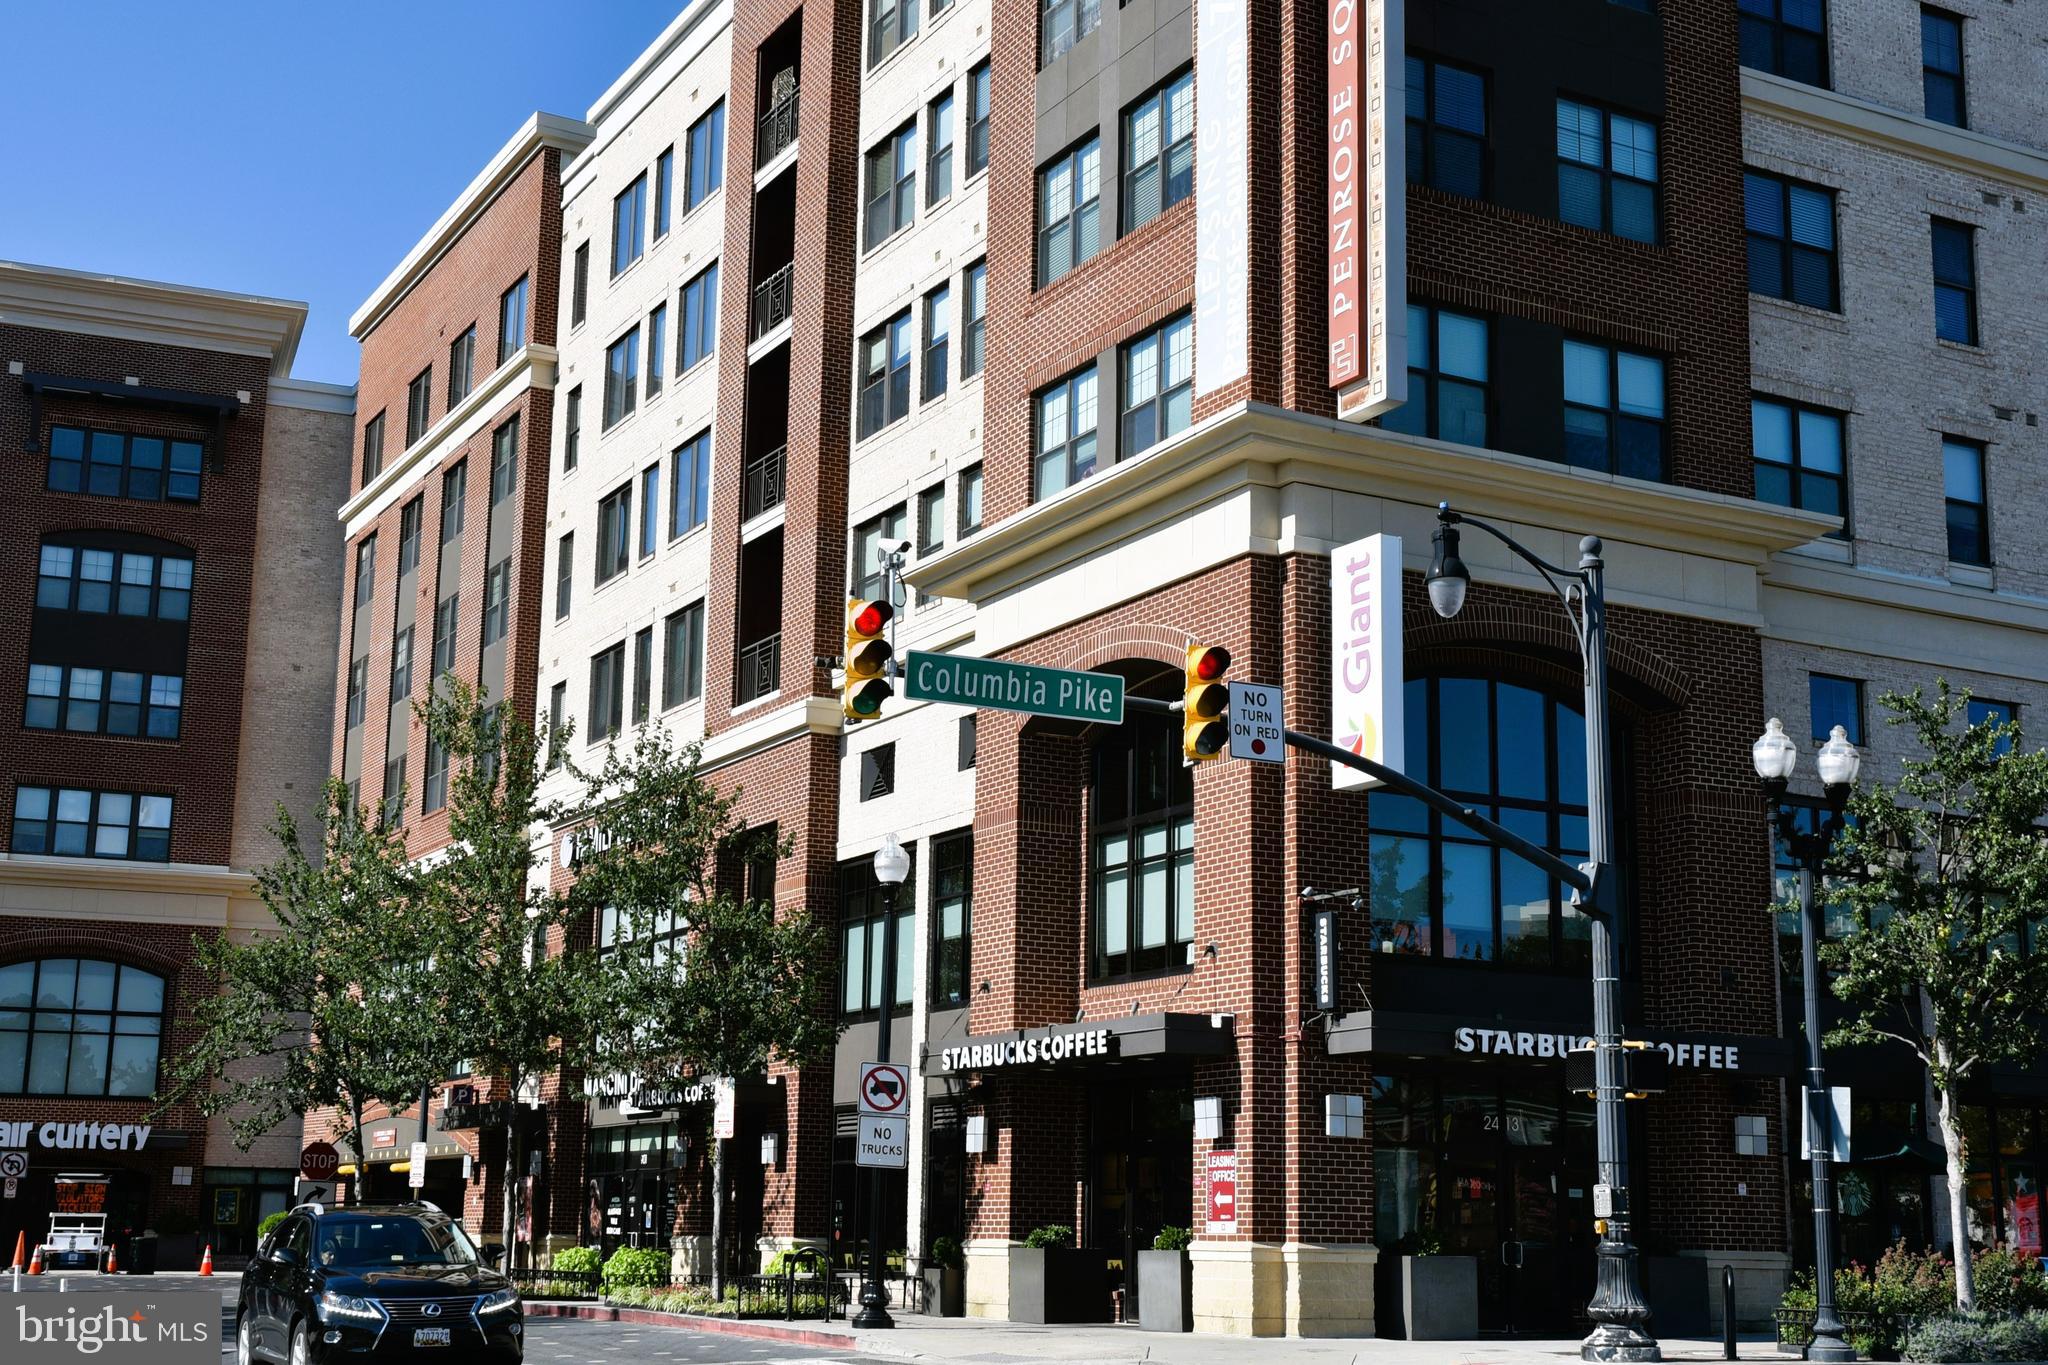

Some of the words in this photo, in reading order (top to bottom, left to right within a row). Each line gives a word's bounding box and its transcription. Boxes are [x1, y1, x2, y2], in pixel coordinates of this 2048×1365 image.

[1333, 0, 1354, 66] SQ
[1333, 85, 1353, 318] PENROSE
[1202, 118, 1221, 319] LEASING
[1342, 552, 1371, 694] Giant
[918, 661, 1046, 706] Columbia
[1059, 678, 1113, 713] Pike
[1244, 691, 1267, 707] NO
[1241, 709, 1272, 723] TURN
[1234, 724, 1251, 737] ON
[1257, 726, 1279, 740] RED
[1319, 917, 1329, 1004] STARBUCKS
[942, 1038, 1038, 1071] STARBUCKS
[1040, 1029, 1108, 1061] COFFEE
[1458, 1027, 1597, 1060] STARBU
[1645, 1041, 1740, 1070] OFFEE
[583, 1072, 628, 1097] MANCINI
[459, 1089, 468, 1102] P
[39, 1120, 152, 1150] cuttery
[873, 1127, 892, 1140] NO
[861, 1143, 903, 1156] TRUCKS
[302, 1153, 338, 1169] STOP
[1208, 1155, 1235, 1168] LEASING
[1212, 1169, 1236, 1182] OFFICE
[56, 1183, 78, 1193] STOP
[84, 1183, 106, 1194] SIGN
[56, 1193, 105, 1203] VIOLATORS
[58, 1203, 102, 1213] TICKETED
